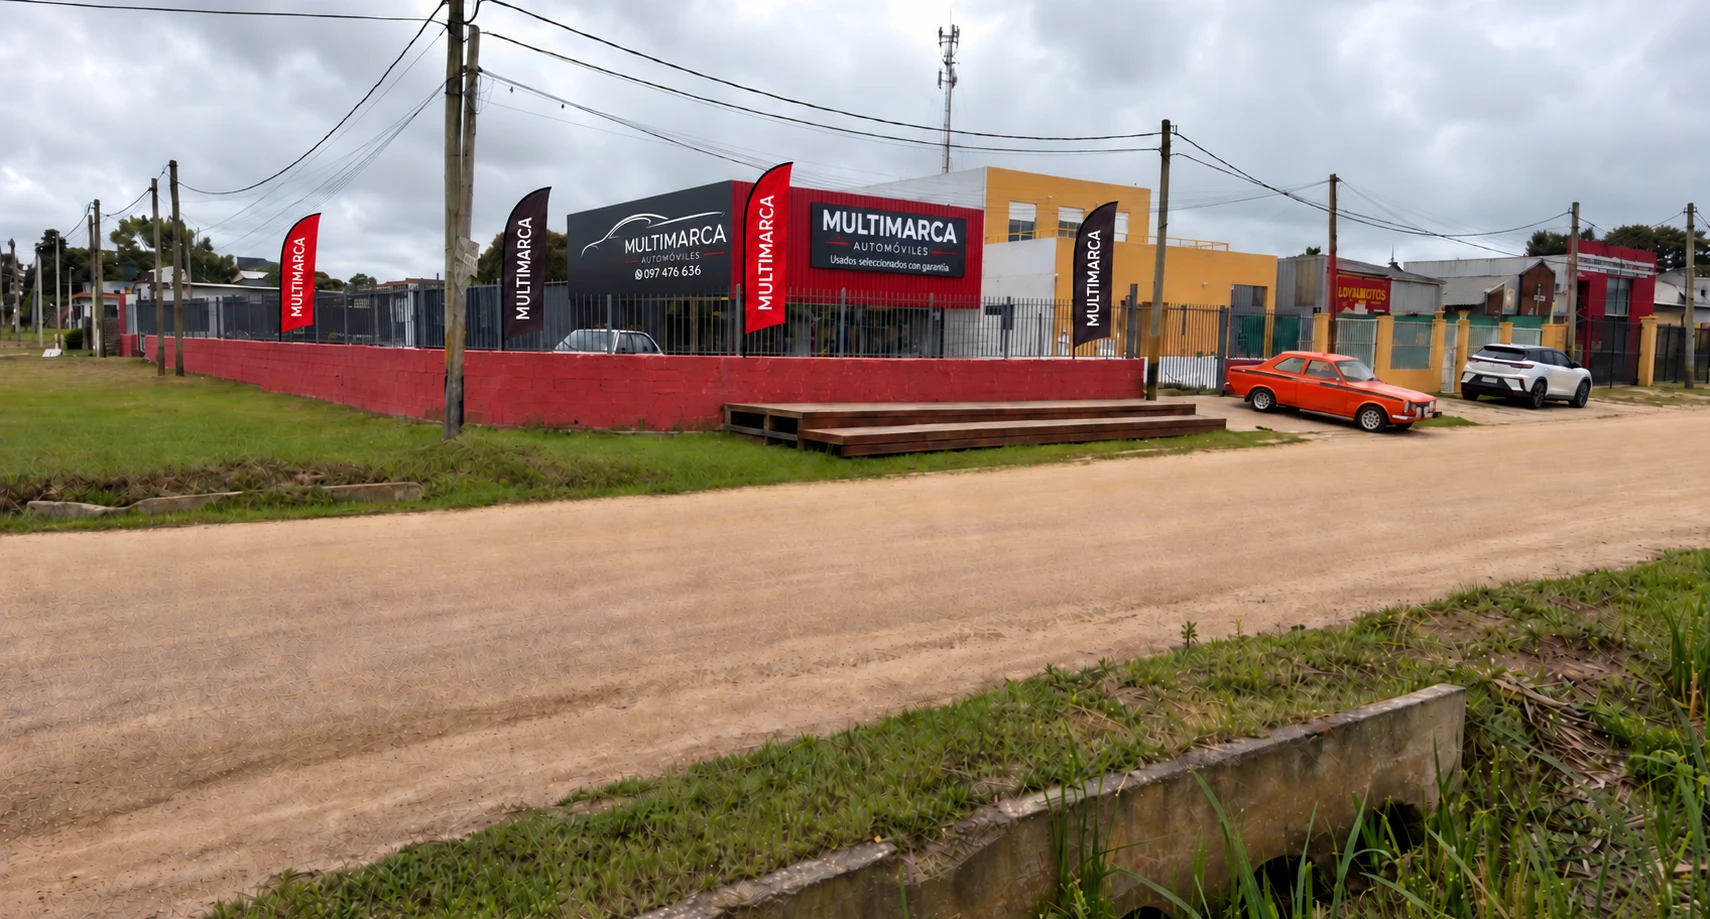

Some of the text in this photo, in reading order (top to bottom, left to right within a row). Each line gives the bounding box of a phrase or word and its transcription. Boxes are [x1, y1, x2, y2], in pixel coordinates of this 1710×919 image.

[625, 224, 727, 254] MULTIMARCA
[823, 209, 957, 244] MULTIMARCA
[641, 251, 700, 264] AUTOMÓVILES
[758, 195, 774, 310] MULTIMARCA
[830, 254, 950, 273] Usados seleccionados con garantía
[853, 241, 929, 256] AUTOMÓVILES
[290, 237, 305, 317] MULTIMARCA
[516, 217, 532, 320] MULTIMARCA
[644, 265, 701, 279] 097 476 636
[1086, 230, 1101, 327] MULTIMARCA
